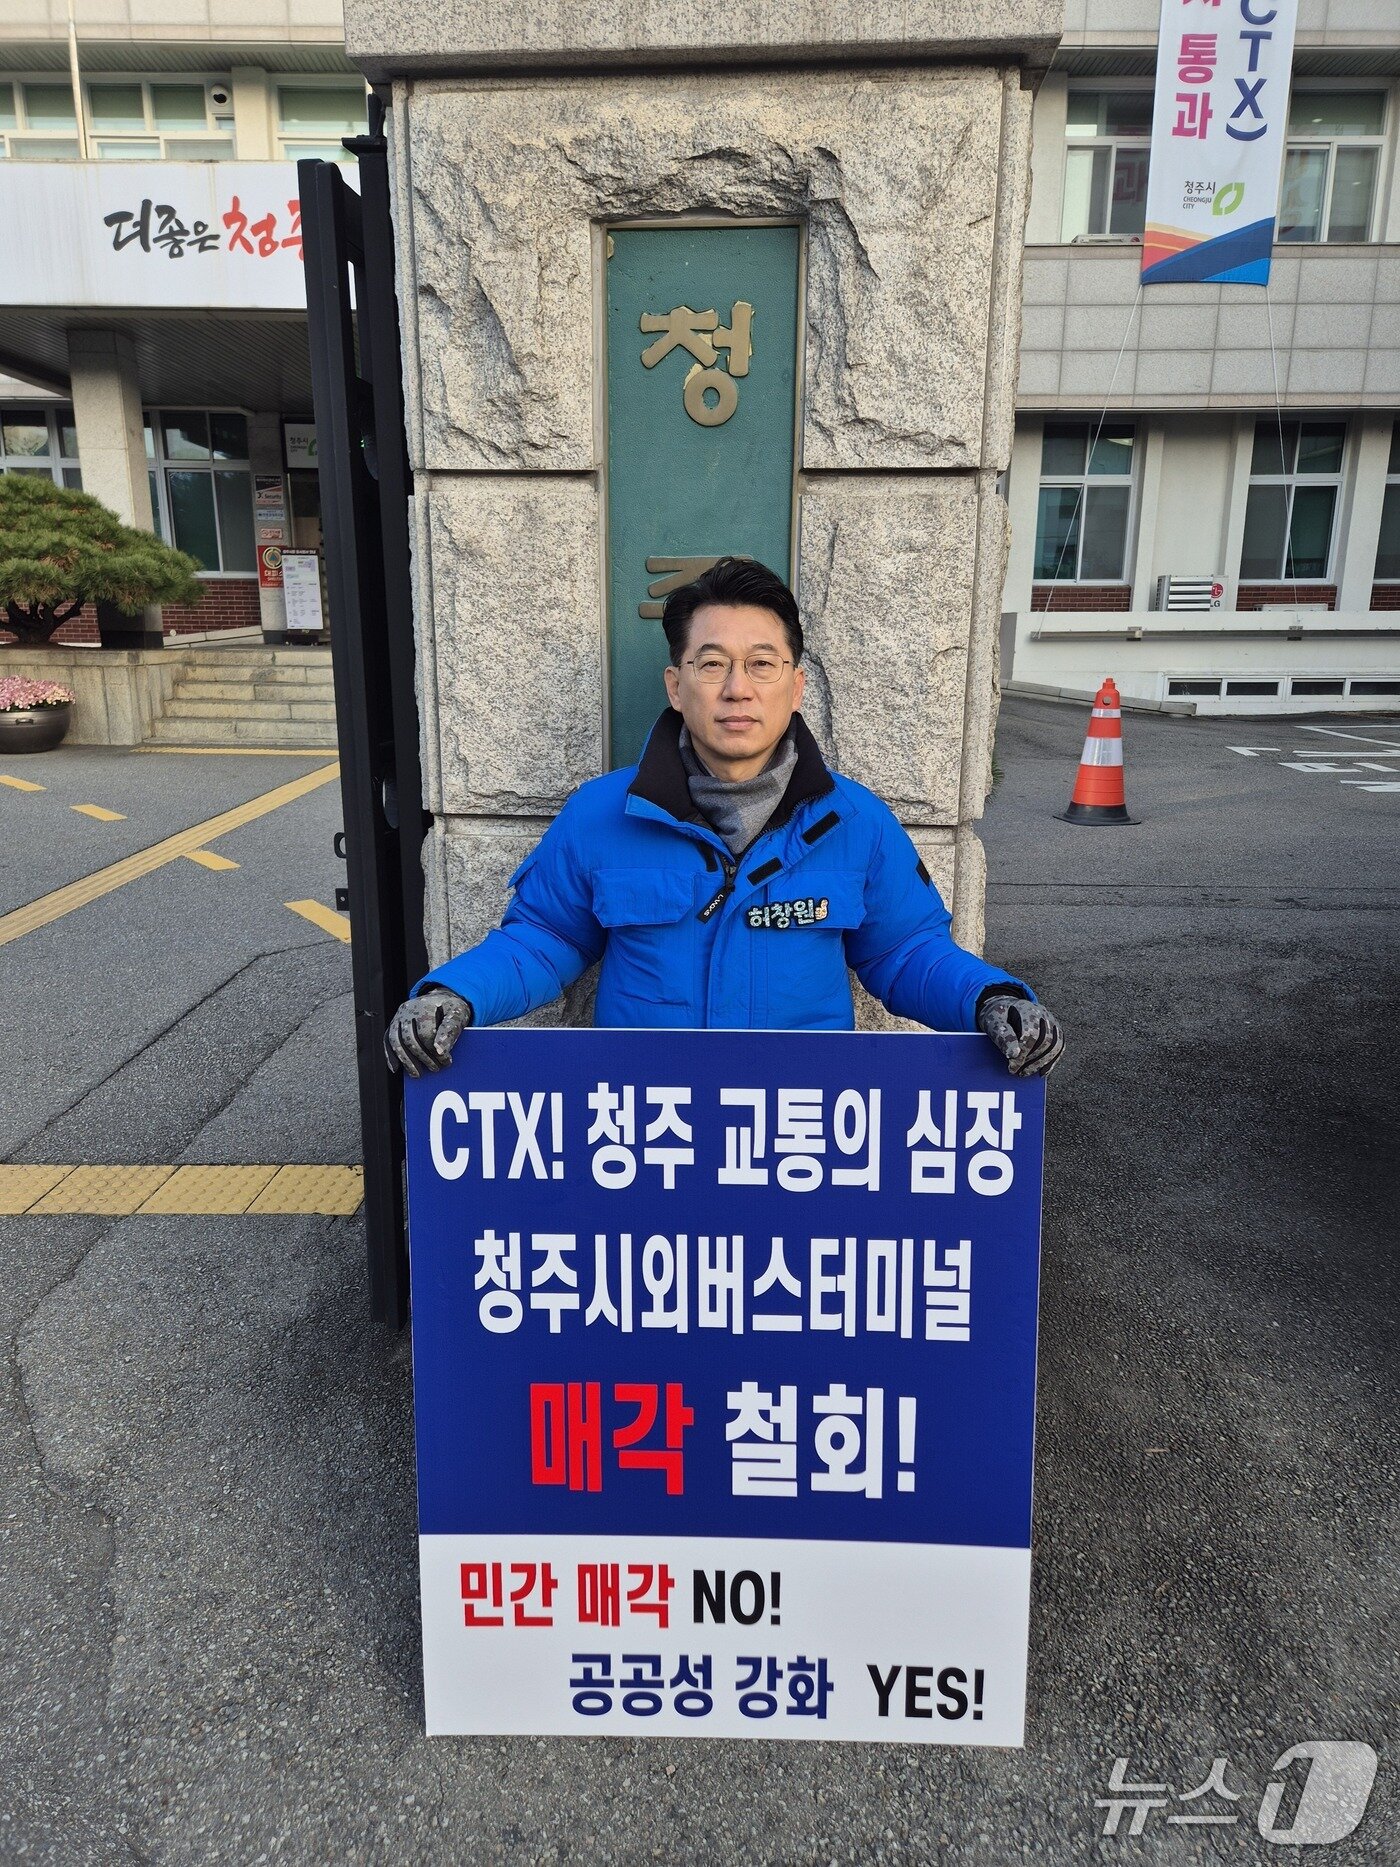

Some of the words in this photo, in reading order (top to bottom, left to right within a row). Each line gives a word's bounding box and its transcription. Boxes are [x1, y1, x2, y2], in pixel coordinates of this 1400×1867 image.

[1172, 33, 1218, 140] 통과
[1183, 196, 1212, 204] CHEONGJU
[1184, 180, 1216, 194] 청주시
[748, 898, 815, 929] 허창원
[429, 1090, 565, 1181] CTX!
[587, 1082, 696, 1190] 청주
[717, 1088, 882, 1193] 교통의
[906, 1089, 1023, 1197] 심장
[474, 1229, 972, 1342] 청주시외버스터미널
[529, 1382, 695, 1496] 매각
[725, 1381, 917, 1499] 철회!
[460, 1562, 559, 1628] 민간
[577, 1563, 676, 1629] 매각
[692, 1569, 782, 1626] NO!
[569, 1653, 714, 1718] 공공성
[735, 1655, 835, 1720] 강화
[866, 1664, 986, 1721] YES!
